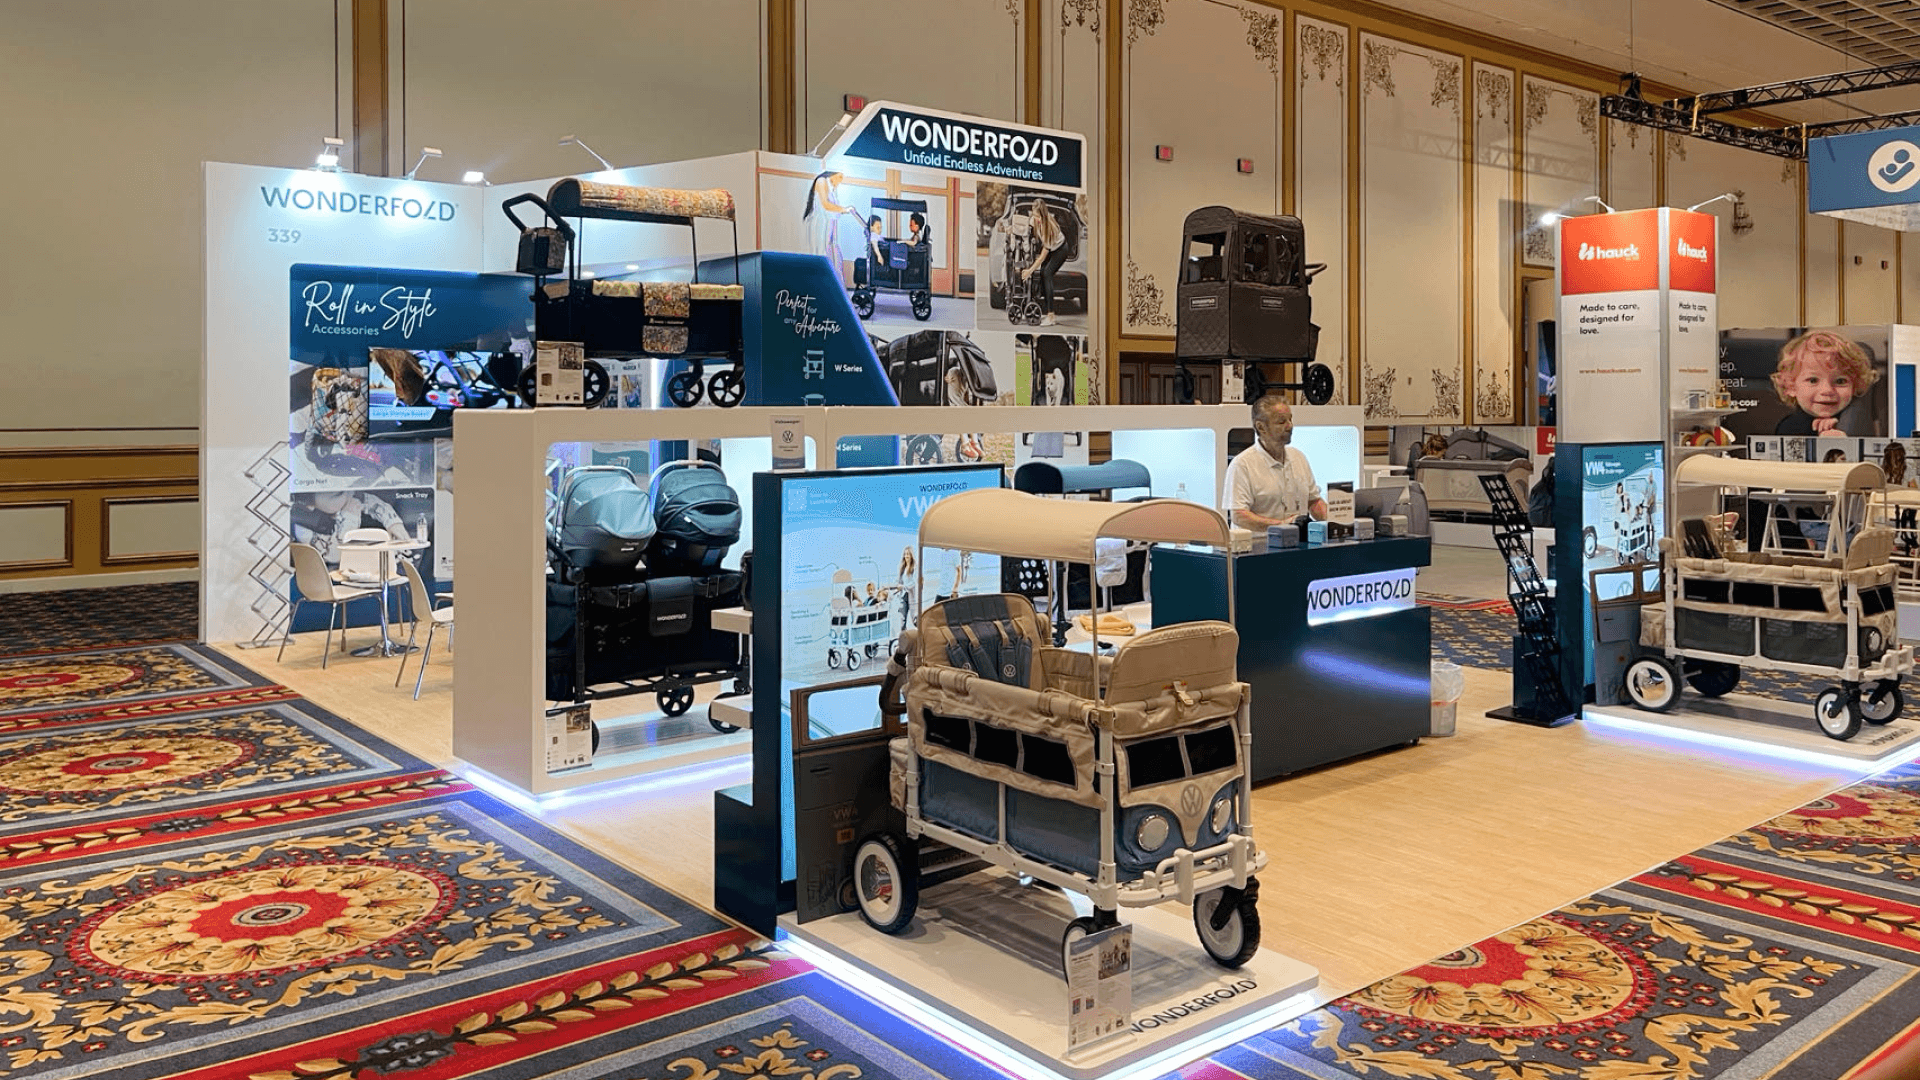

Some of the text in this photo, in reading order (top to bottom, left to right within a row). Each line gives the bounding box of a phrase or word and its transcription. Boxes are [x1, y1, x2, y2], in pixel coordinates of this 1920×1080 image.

[881, 112, 1059, 167] WONDERFOLD
[904, 150, 1044, 182] Unfold Endless Adventures
[261, 186, 456, 222] WONDERFOLD
[268, 228, 302, 244] 339
[1596, 244, 1638, 259] hauck
[775, 289, 818, 317] Perfect for
[1579, 304, 1605, 313] Made
[1607, 304, 1616, 312] to
[302, 280, 438, 340] Roll in Style
[1579, 313, 1635, 325] designed for
[311, 323, 380, 336] Accessories
[794, 314, 842, 340] Adventure
[1579, 326, 1600, 336] love.
[834, 363, 863, 373] W Series
[1720, 361, 1737, 374] ep.
[1720, 376, 1747, 389] peat.
[842, 442, 863, 452] Series
[294, 477, 328, 487] Cargo Net
[395, 491, 429, 501] Snack Tray
[898, 495, 943, 519] VW
